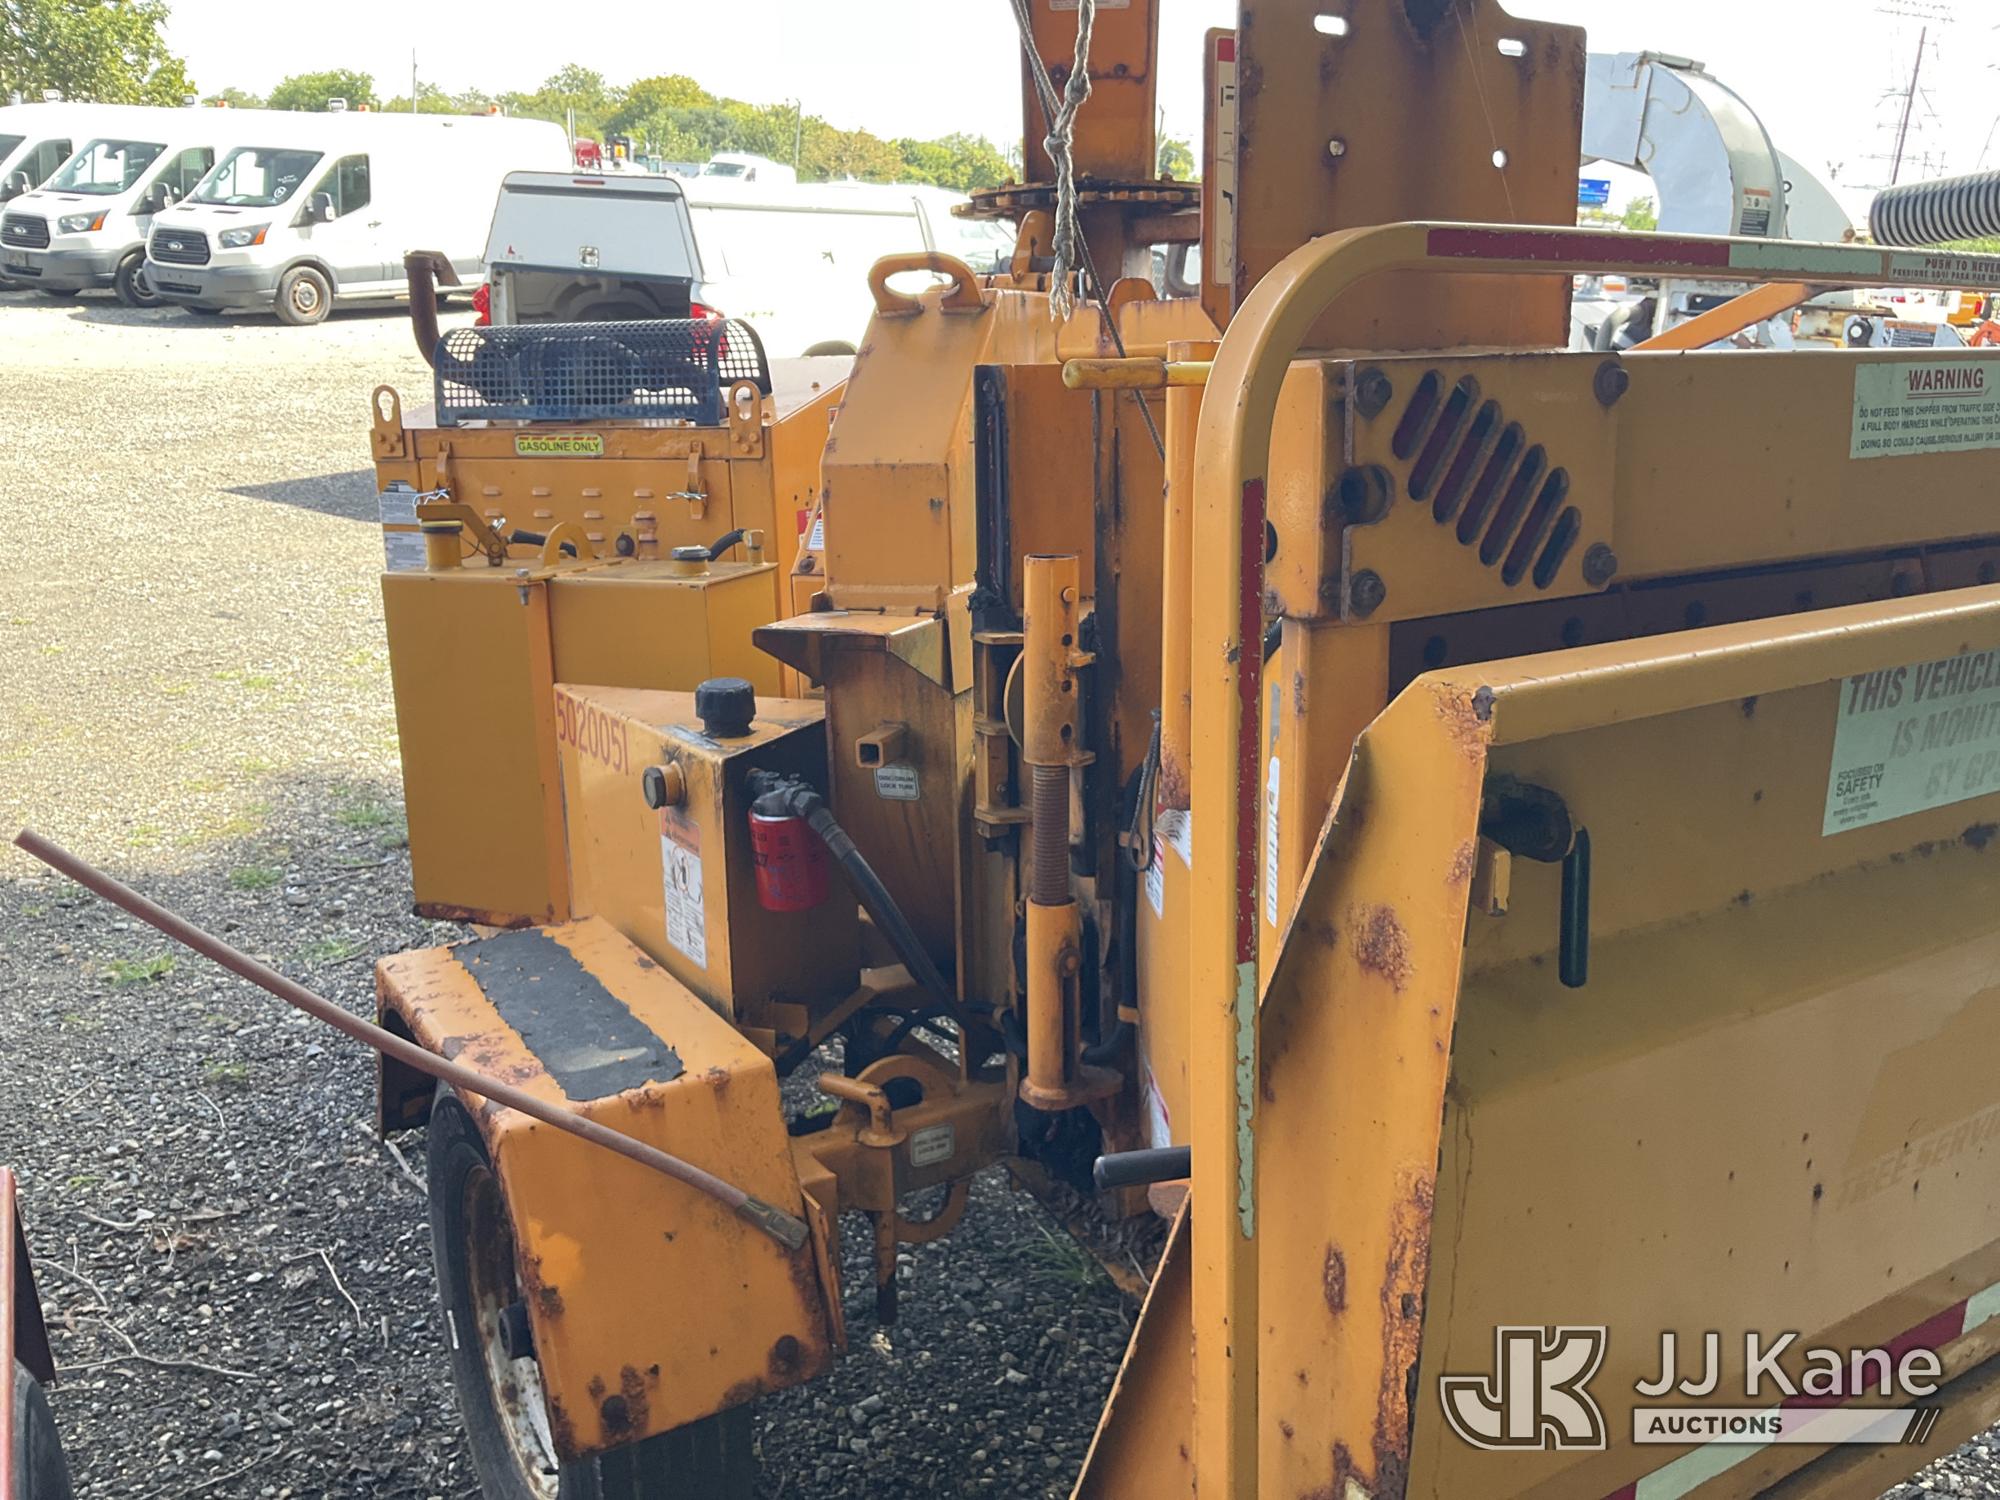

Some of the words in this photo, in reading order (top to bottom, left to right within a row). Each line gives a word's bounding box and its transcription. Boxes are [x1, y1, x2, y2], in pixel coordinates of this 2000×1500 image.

[1925, 258, 1951, 270] PUSH
[1957, 260, 1968, 271] TO
[1908, 368, 1984, 391] WARNING
[1859, 408, 1869, 418] DO
[1870, 408, 1883, 418] NOT
[1883, 407, 1900, 417] FEED
[1901, 406, 1914, 416] THIS
[1941, 405, 1958, 414] FROM
[1959, 404, 1981, 413] TRAFFIC
[1883, 421, 1900, 431] BODY
[1901, 419, 1928, 430] HARNESS
[518, 441, 571, 452] GASOLINE
[573, 441, 600, 452] ONLY
[1860, 439, 1881, 449] DOING
[1882, 438, 1892, 448] SO
[1893, 437, 1914, 447] COULD
[1963, 432, 1984, 442] INJURY
[1848, 666, 1907, 715] THIS
[556, 690, 629, 777] 5020051
[1889, 717, 1919, 760] IS
[1919, 701, 2000, 752] MONIT
[1836, 773, 1884, 797] SAFETY
